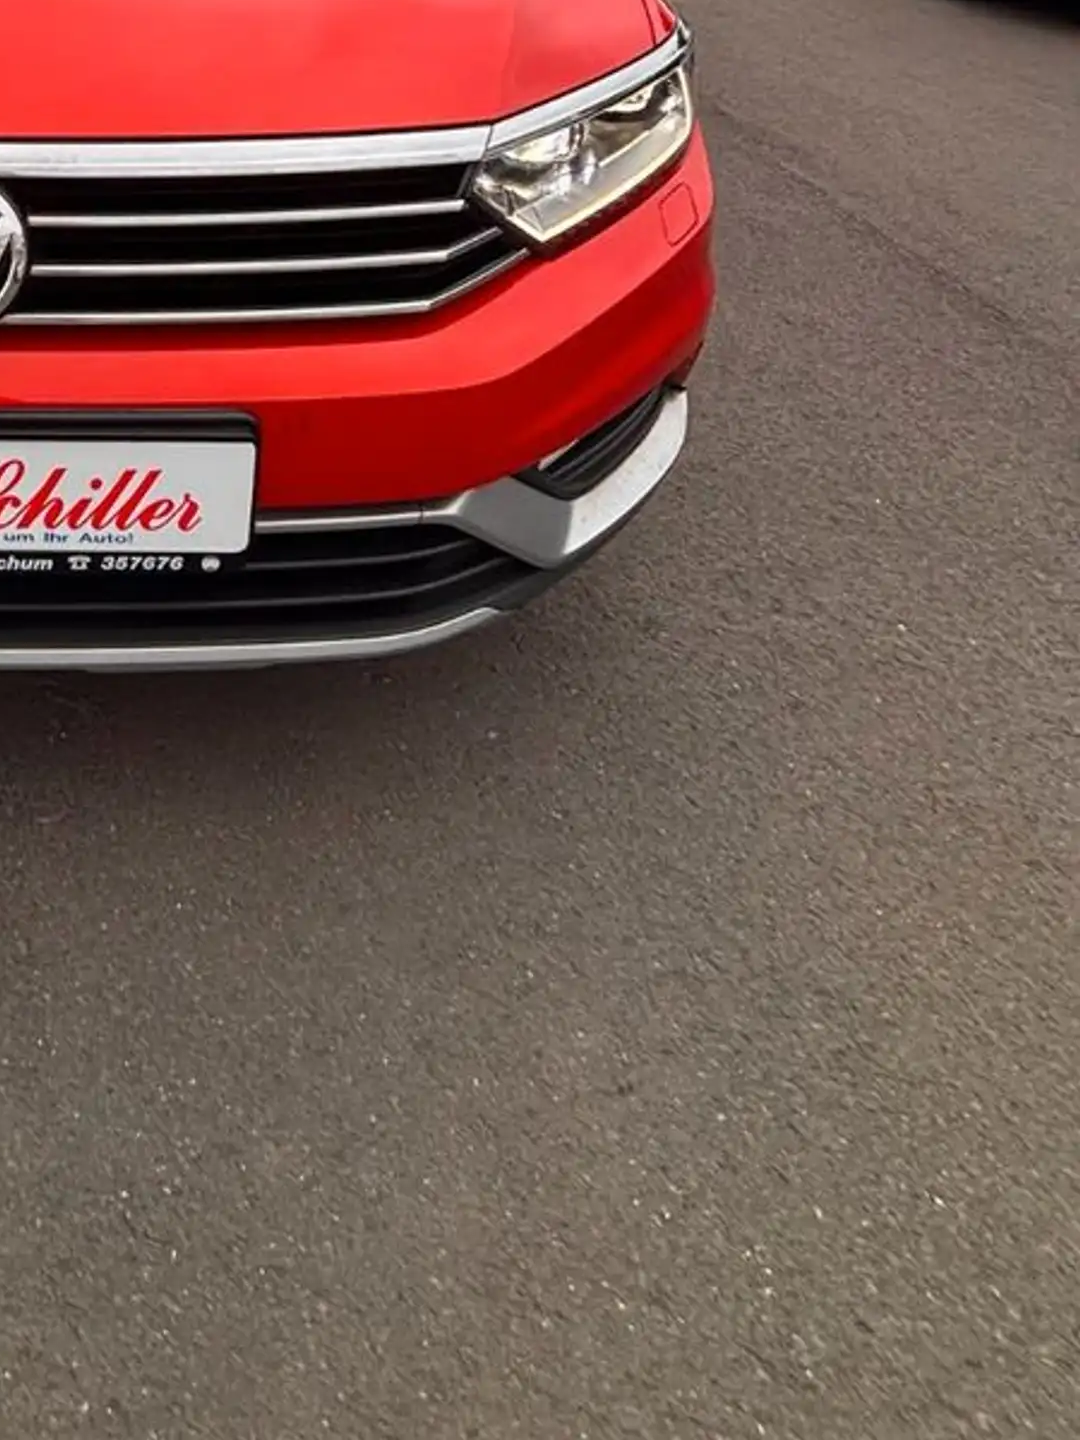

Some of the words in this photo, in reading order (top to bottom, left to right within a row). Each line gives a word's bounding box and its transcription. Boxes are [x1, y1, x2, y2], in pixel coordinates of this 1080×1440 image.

[3, 533, 35, 543] um
[43, 531, 69, 543] Ihr
[78, 532, 134, 545] Auto!
[100, 556, 185, 572] 357676
